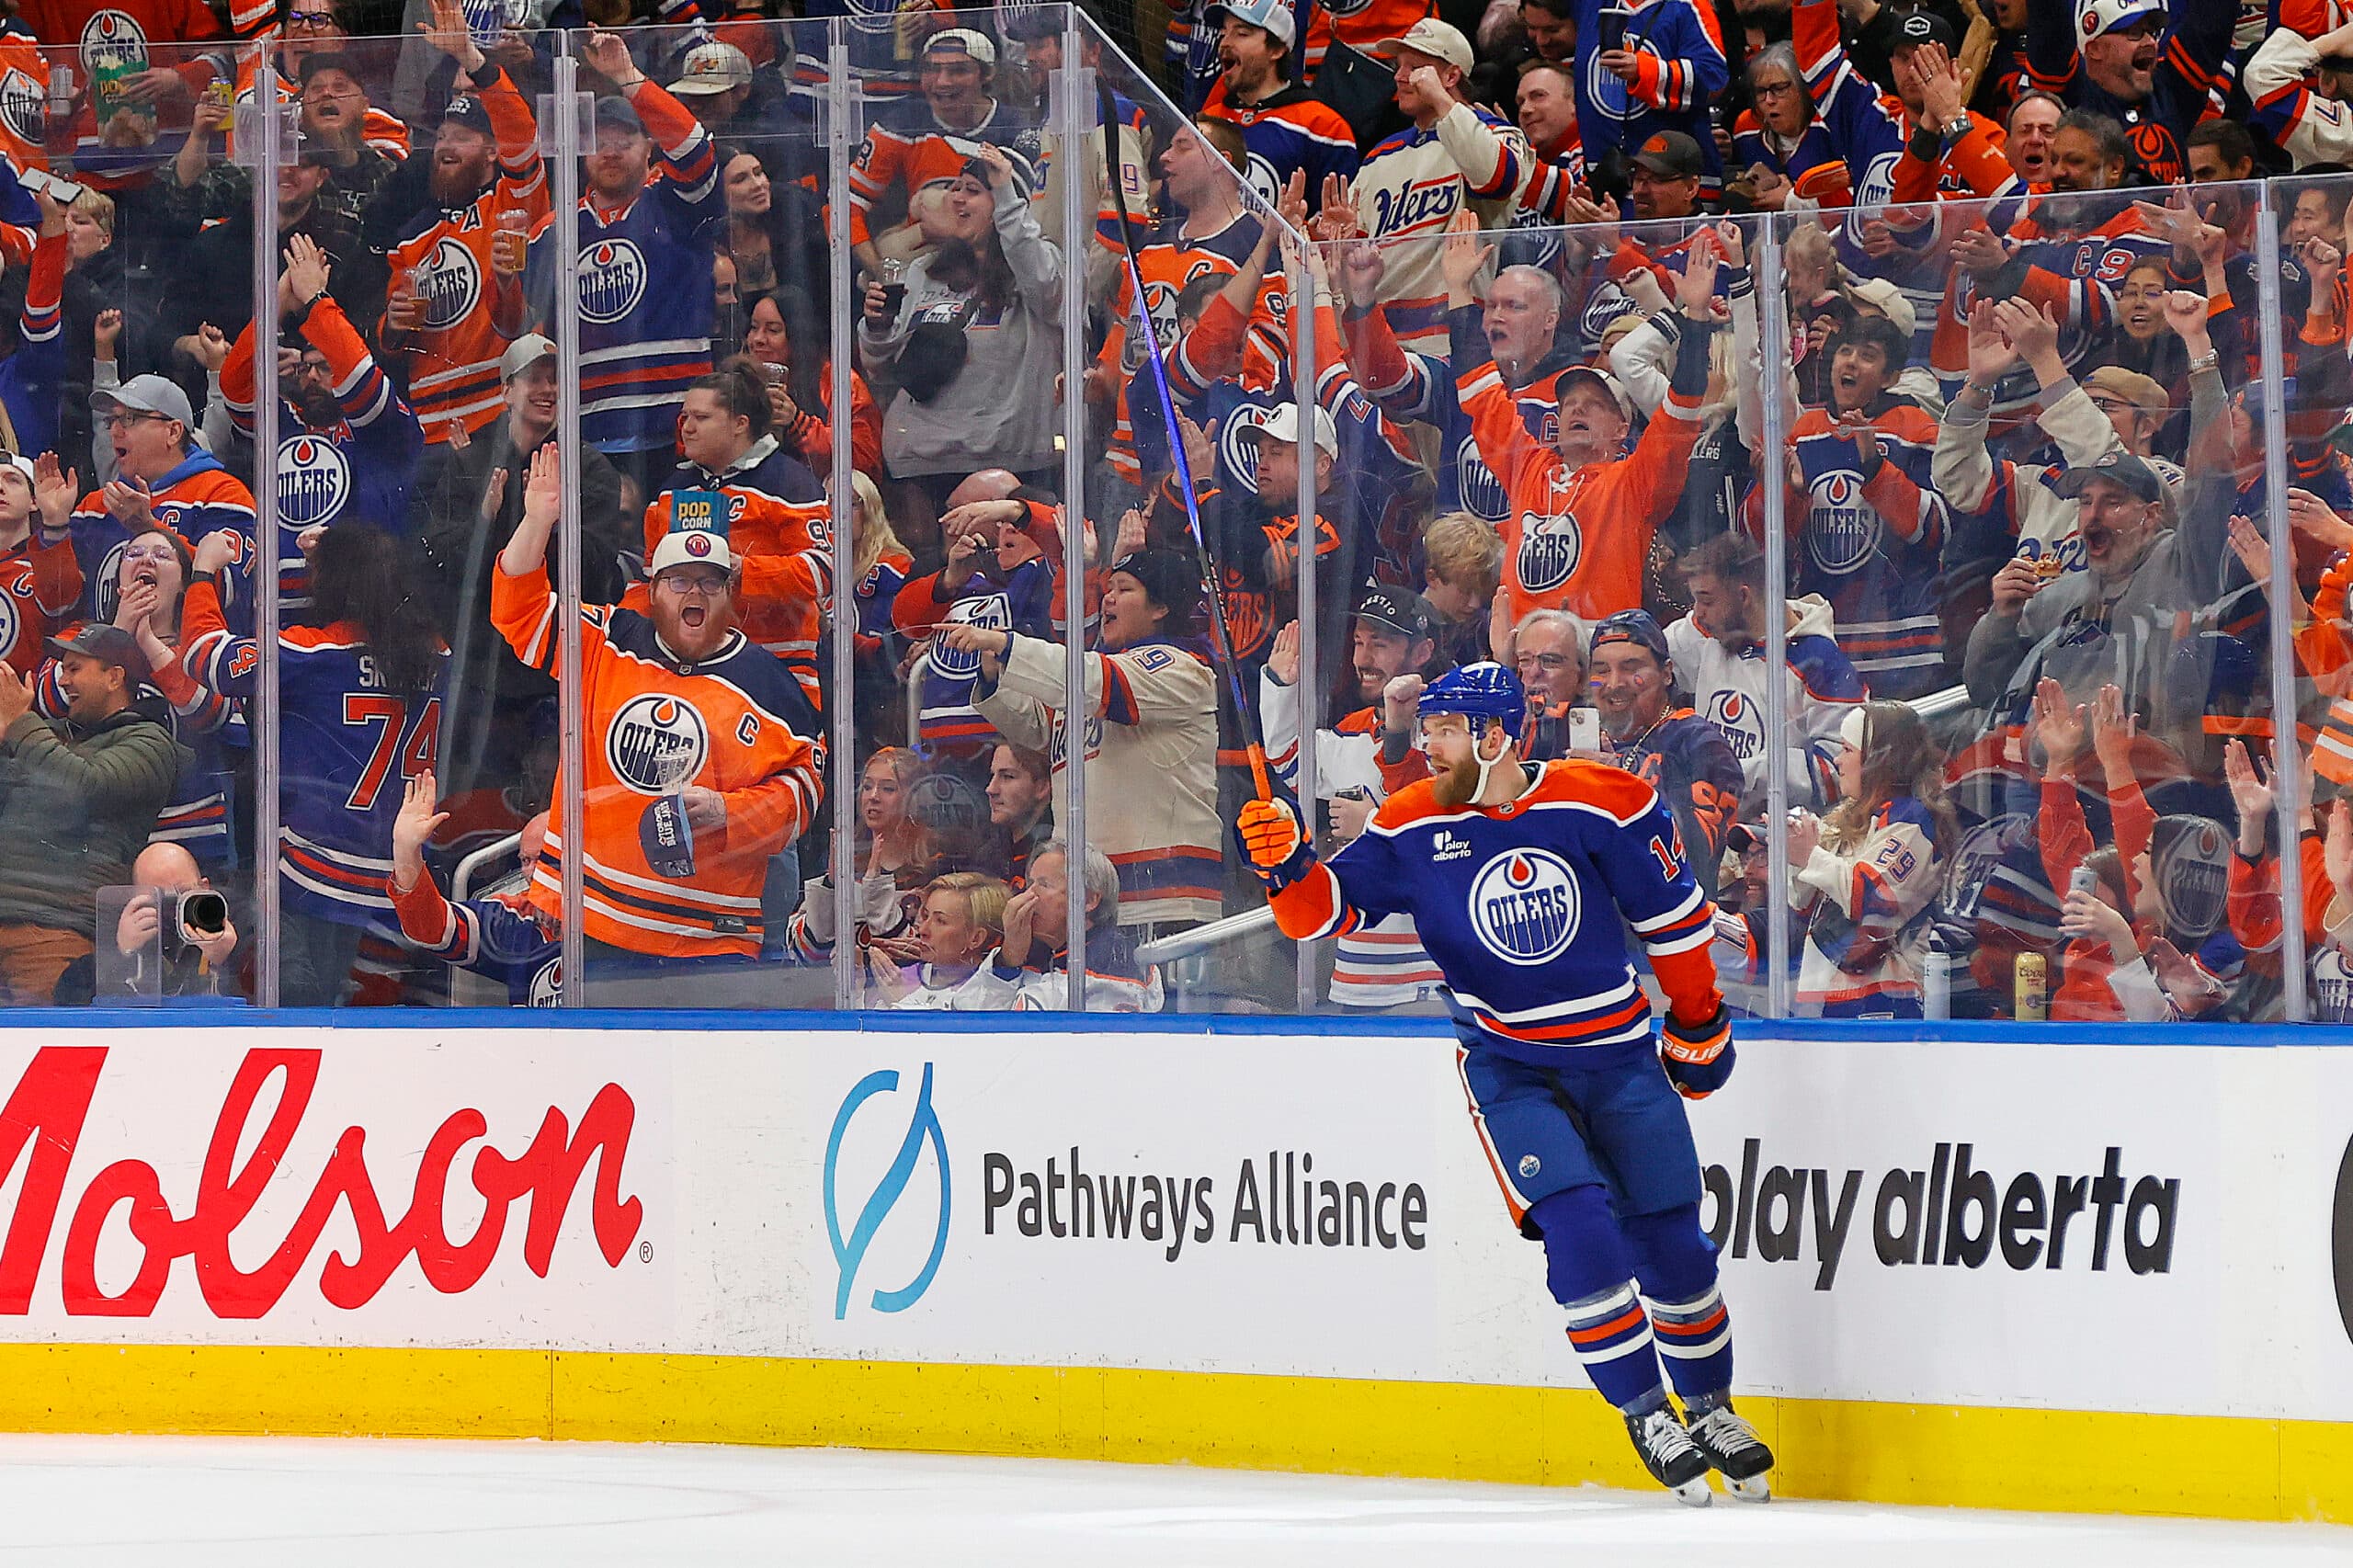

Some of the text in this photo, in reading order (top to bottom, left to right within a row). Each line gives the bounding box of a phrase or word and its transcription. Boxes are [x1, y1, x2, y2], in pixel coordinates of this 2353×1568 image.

[460, 203, 483, 232] A
[2073, 244, 2092, 276] C
[578, 261, 641, 297] OILERS
[332, 416, 355, 447] A
[677, 502, 711, 521] POP
[682, 517, 711, 529] CORN
[11, 570, 35, 598] C
[735, 711, 760, 747] C
[342, 692, 442, 812] 74
[654, 806, 665, 840] TORONTO
[664, 821, 677, 847] BLUE
[1433, 848, 1472, 862] alberta
[1445, 840, 1471, 852] play
[1878, 835, 1919, 883] 29
[1486, 883, 1569, 935] OILERS
[983, 1145, 1428, 1263] Pathways Alliance
[1871, 1142, 2181, 1275] alberta
